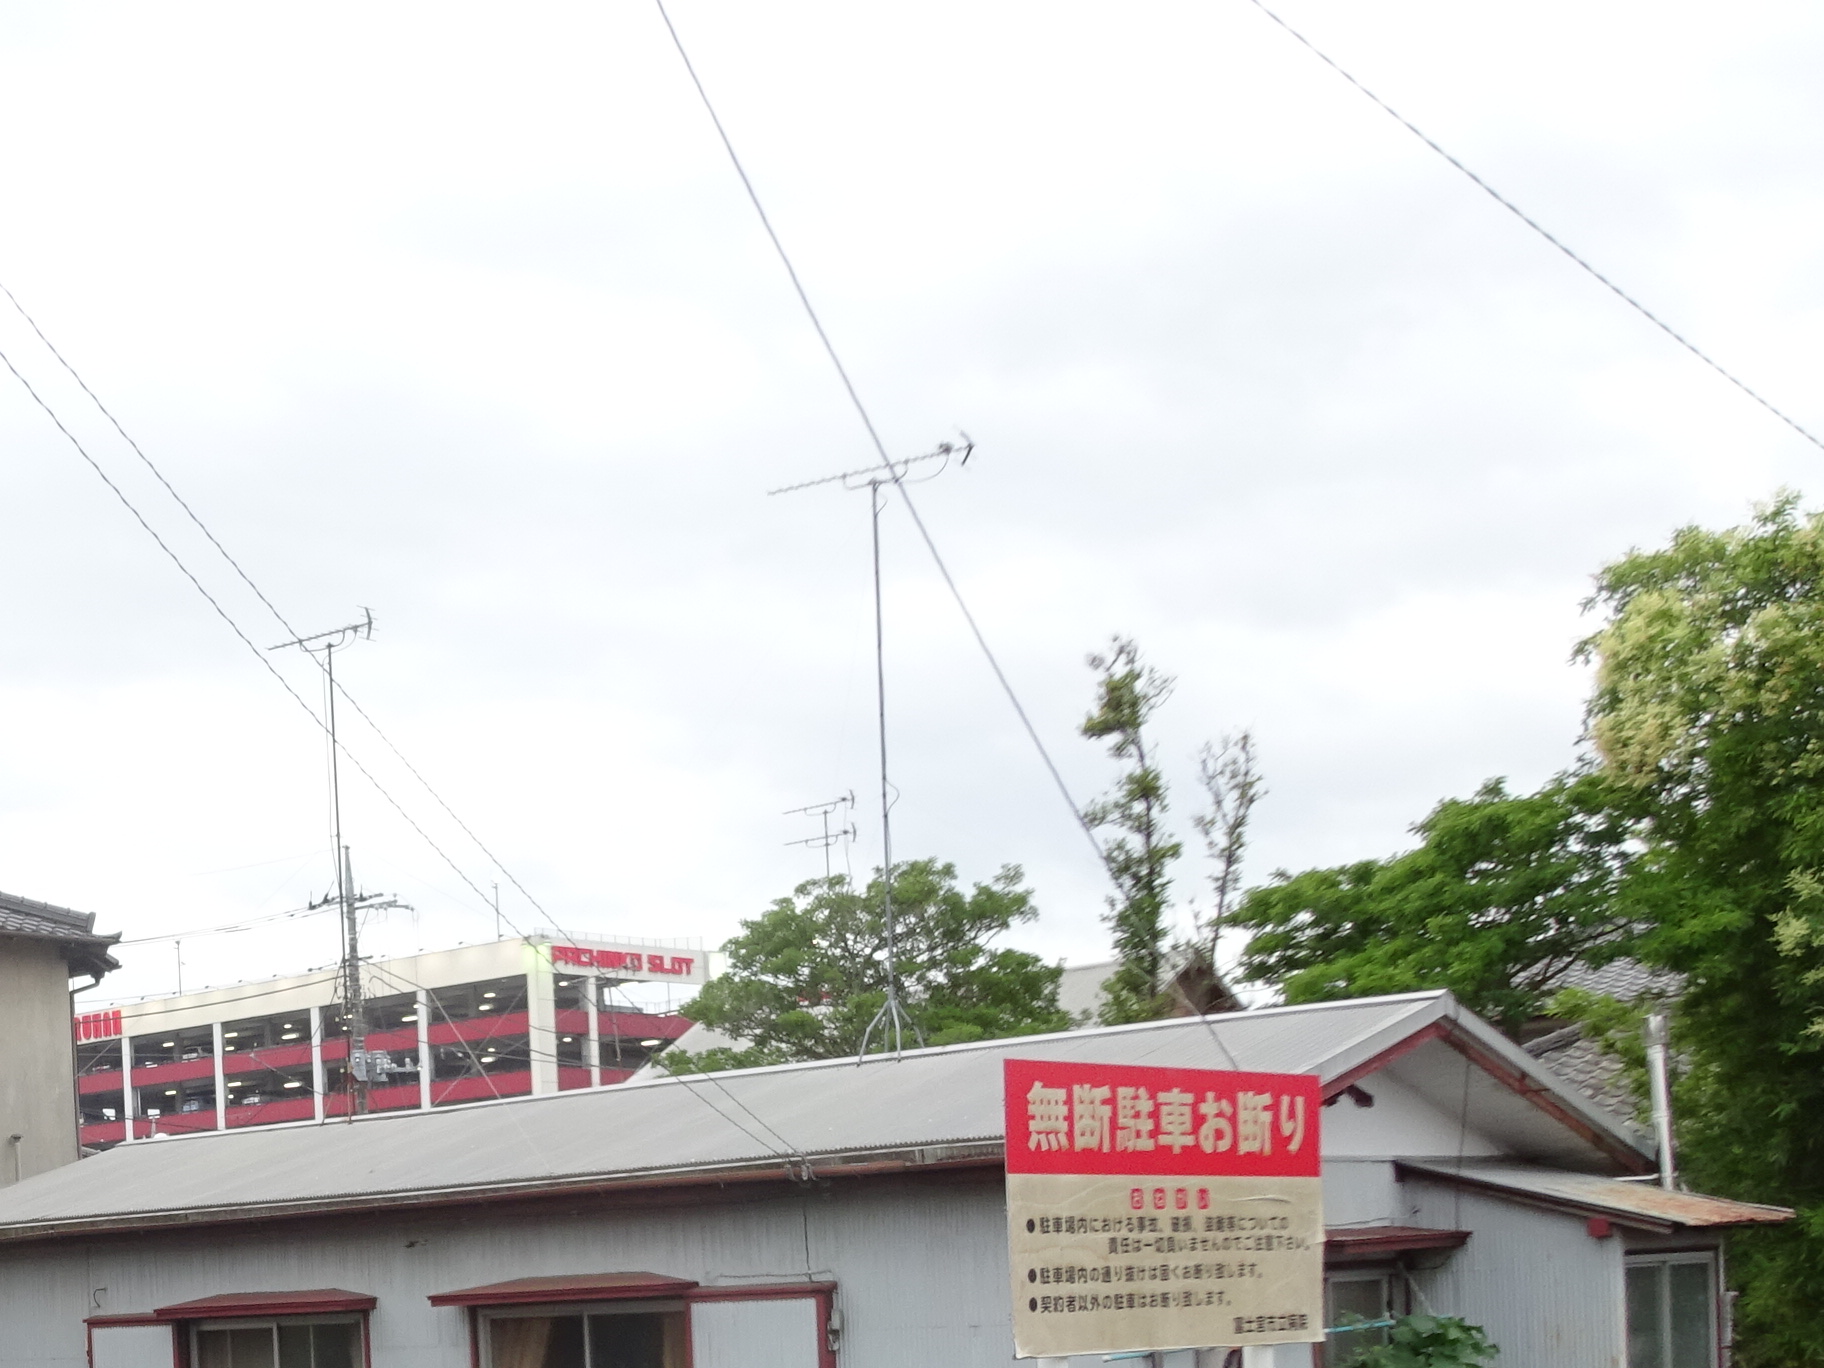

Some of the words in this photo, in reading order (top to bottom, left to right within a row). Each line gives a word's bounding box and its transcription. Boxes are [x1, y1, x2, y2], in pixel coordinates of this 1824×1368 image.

[648, 954, 694, 975] SLOT
[1027, 1080, 1307, 1156] 無断駐車お断り
